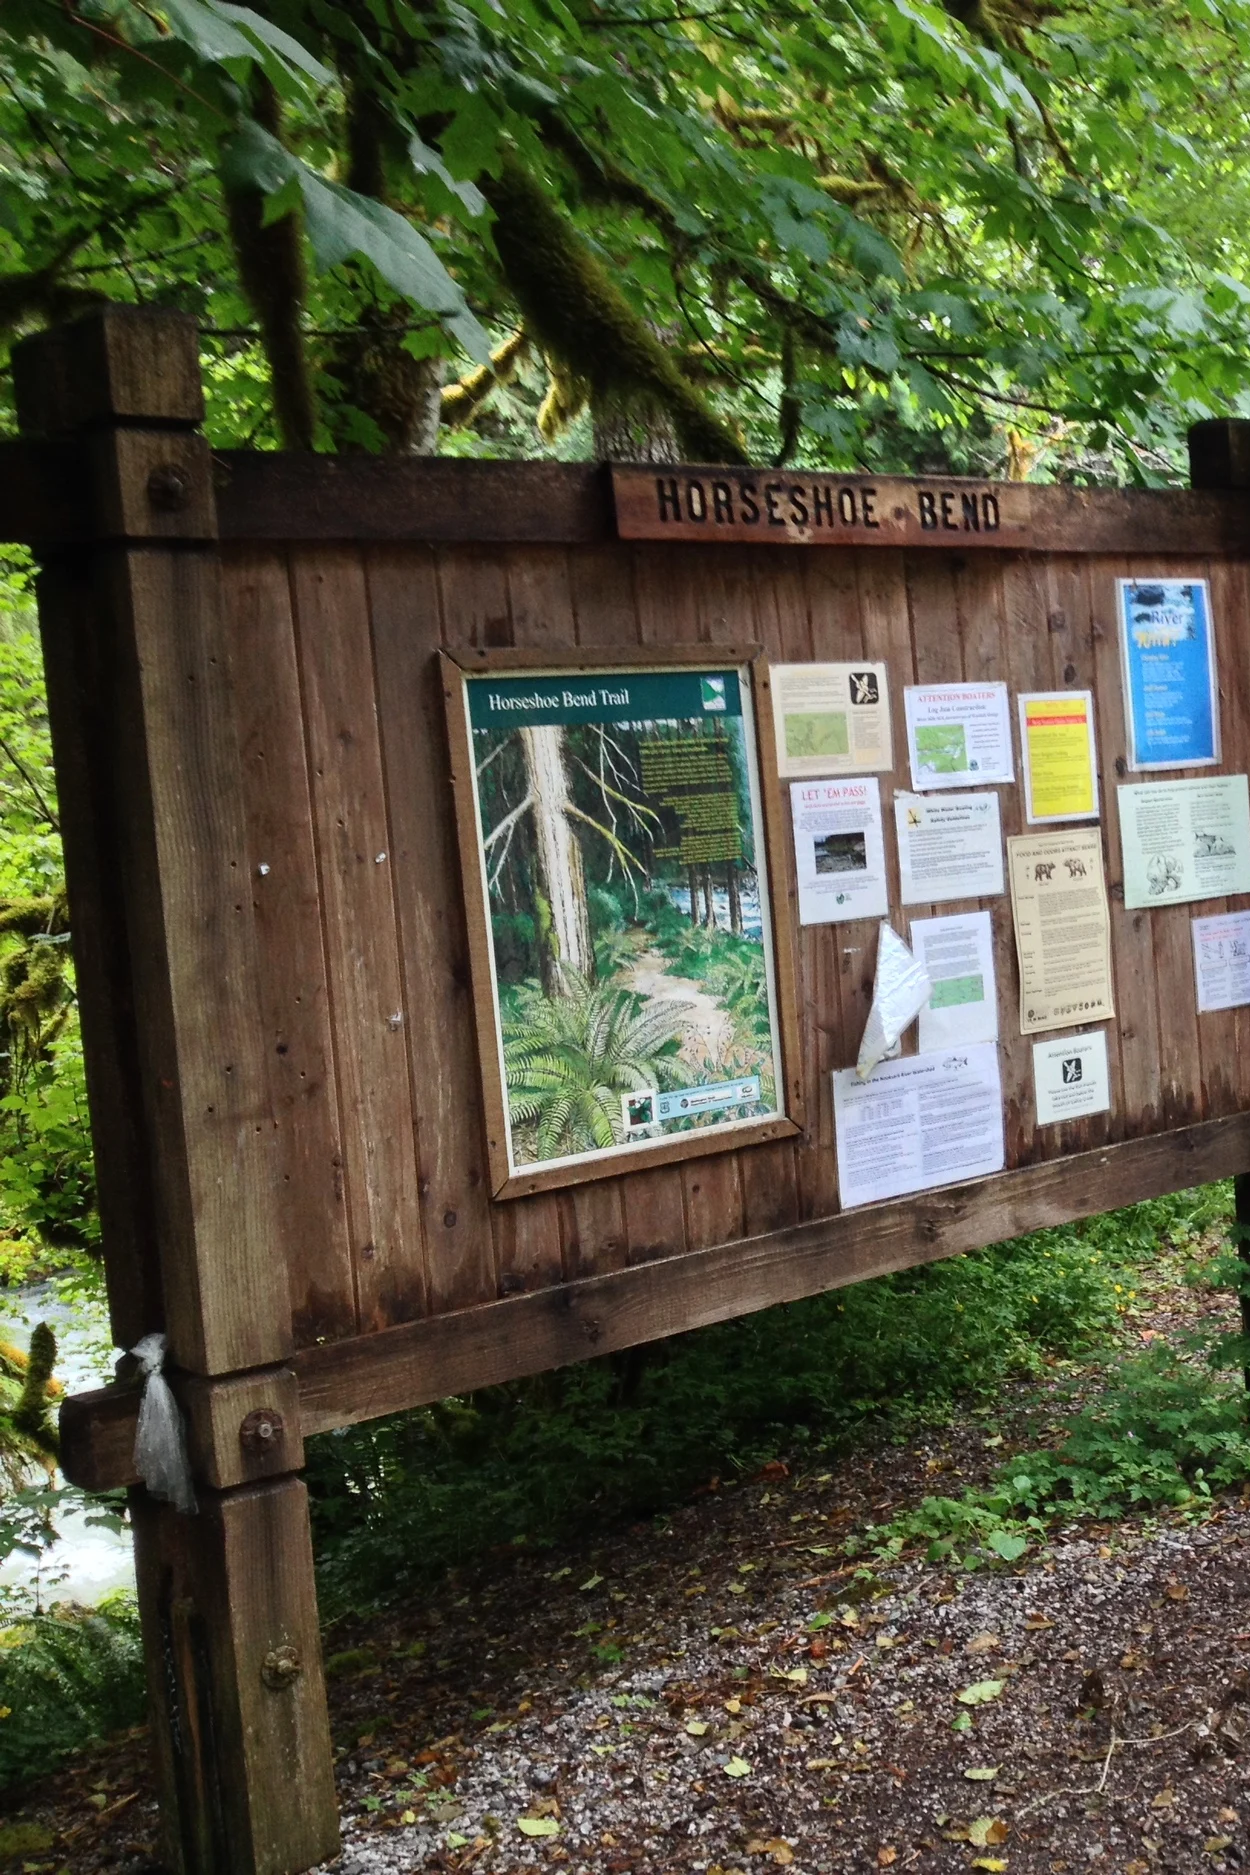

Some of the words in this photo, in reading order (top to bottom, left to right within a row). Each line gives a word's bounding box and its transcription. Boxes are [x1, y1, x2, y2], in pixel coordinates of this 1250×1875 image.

[656, 478, 881, 529] HORSESHOE
[918, 489, 1000, 532] BEND
[1151, 611, 1184, 625] River
[488, 692, 560, 711] Horseshoe
[562, 690, 598, 708] Bend
[599, 688, 630, 706] Trail
[917, 693, 960, 703] ATTENTION
[961, 691, 996, 701] BOATERS
[801, 789, 820, 801] LET
